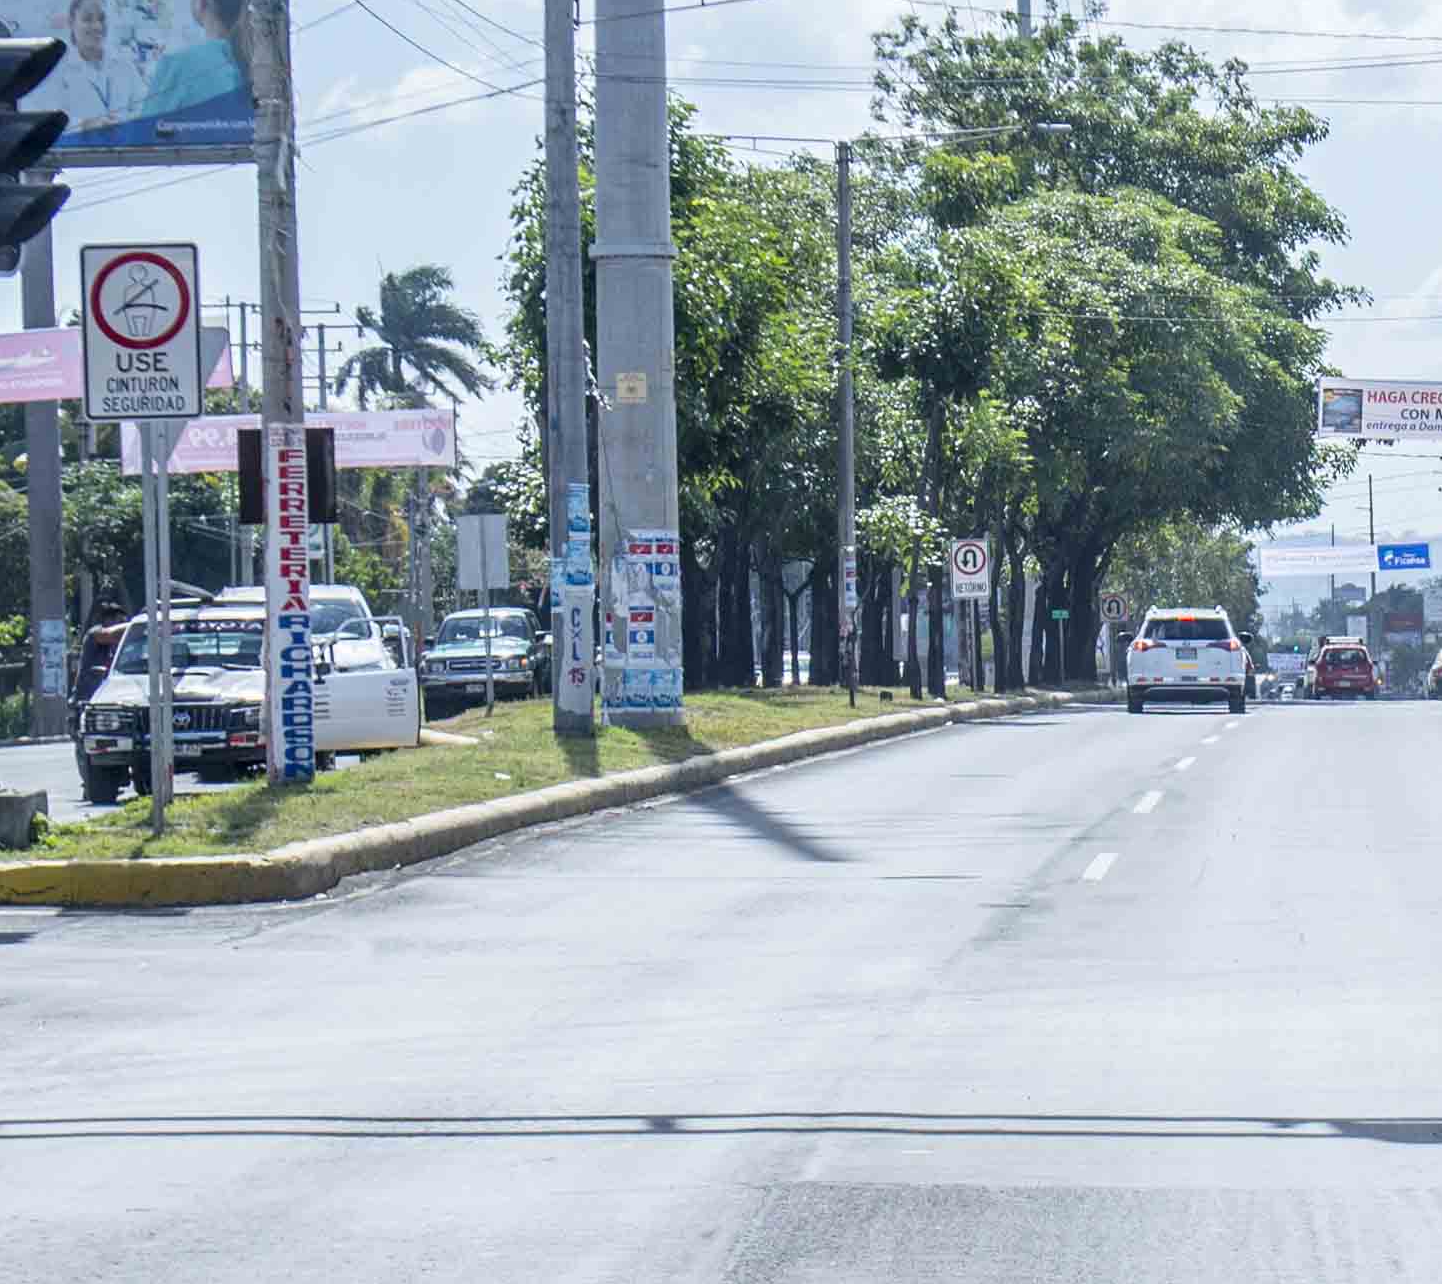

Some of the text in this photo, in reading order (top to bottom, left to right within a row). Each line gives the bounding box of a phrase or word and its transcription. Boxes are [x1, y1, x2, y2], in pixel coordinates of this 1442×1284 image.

[115, 351, 169, 373] USE
[106, 376, 180, 393] CINTURON
[101, 394, 186, 414] SEGURIDAD
[1367, 390, 1408, 404] HAGA
[1400, 408, 1430, 421] CON
[1366, 420, 1408, 432] entrega
[277, 449, 307, 611] FERRETERIA
[278, 614, 314, 778] RICHARDSON
